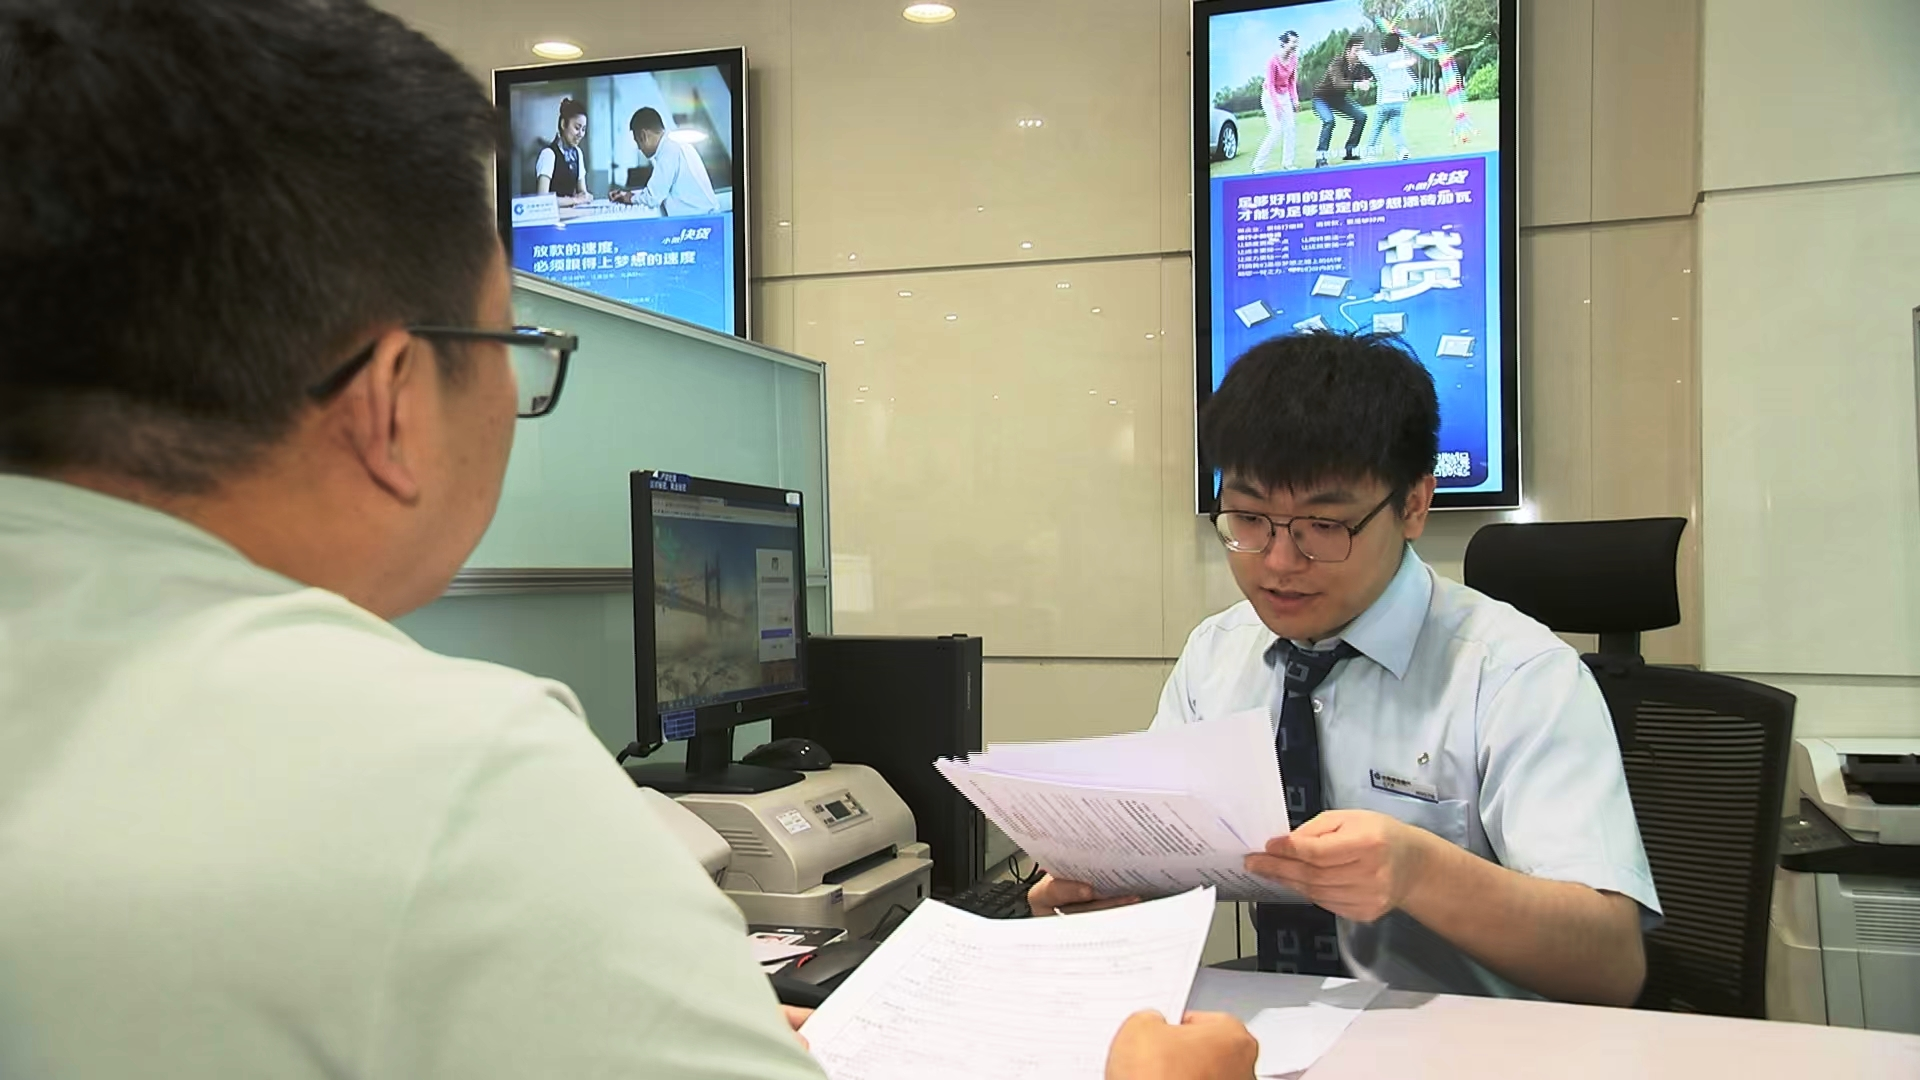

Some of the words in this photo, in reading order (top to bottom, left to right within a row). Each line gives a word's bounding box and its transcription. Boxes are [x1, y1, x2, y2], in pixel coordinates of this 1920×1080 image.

[1237, 187, 1352, 210] 足够好用的贷款
[1237, 189, 1473, 222] 才能为足够坚定的梦想添砖加瓦
[532, 251, 697, 274] 必须跟得上梦想的速度
